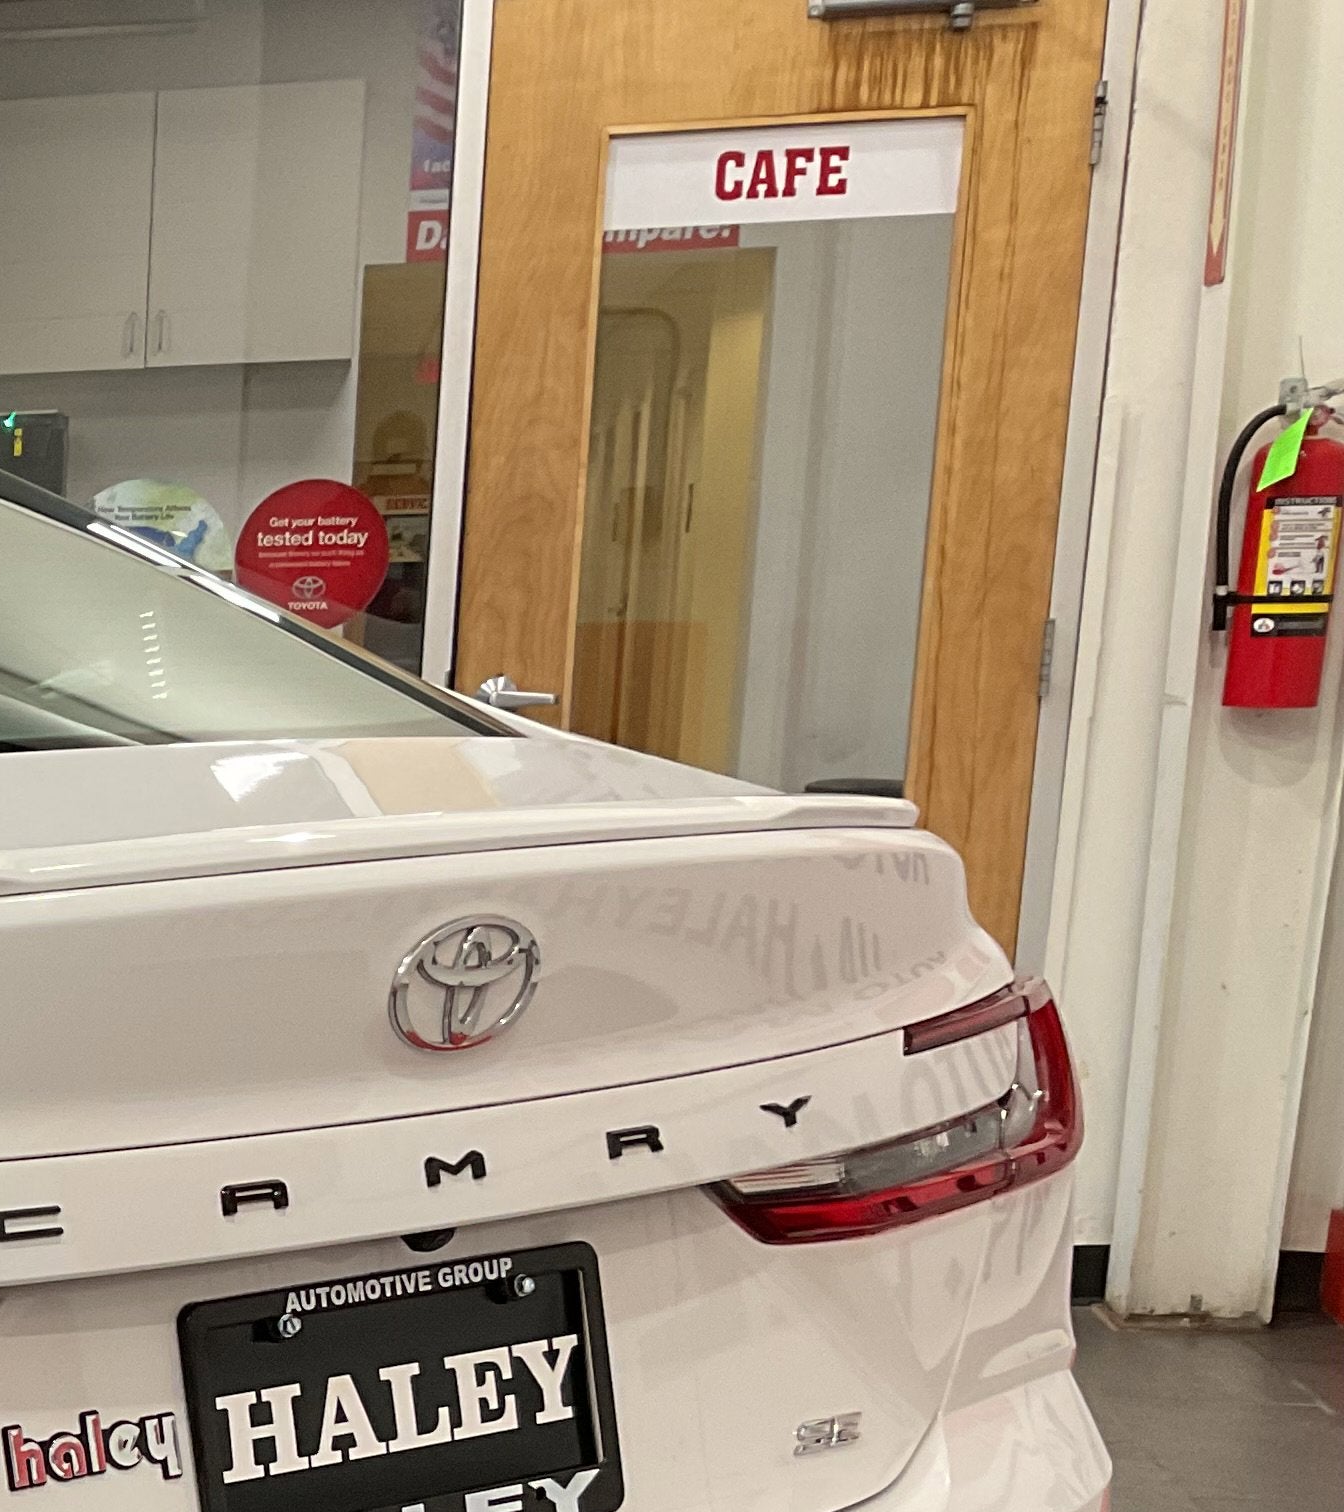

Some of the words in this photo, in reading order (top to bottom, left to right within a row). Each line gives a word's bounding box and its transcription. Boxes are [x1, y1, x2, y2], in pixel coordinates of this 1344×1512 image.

[715, 146, 850, 201] CAFE
[257, 530, 313, 547] tested
[318, 528, 368, 547] today
[269, 516, 289, 528] Get
[291, 518, 315, 529] your
[317, 516, 359, 528] battery
[288, 601, 328, 611] TOYOTA
[285, 1269, 432, 1314] AUTOMOTIVE
[437, 1257, 513, 1288] GROUP
[215, 1333, 579, 1485] HALEY
[793, 1411, 862, 1456] SE
[1, 1409, 183, 1491] haley
